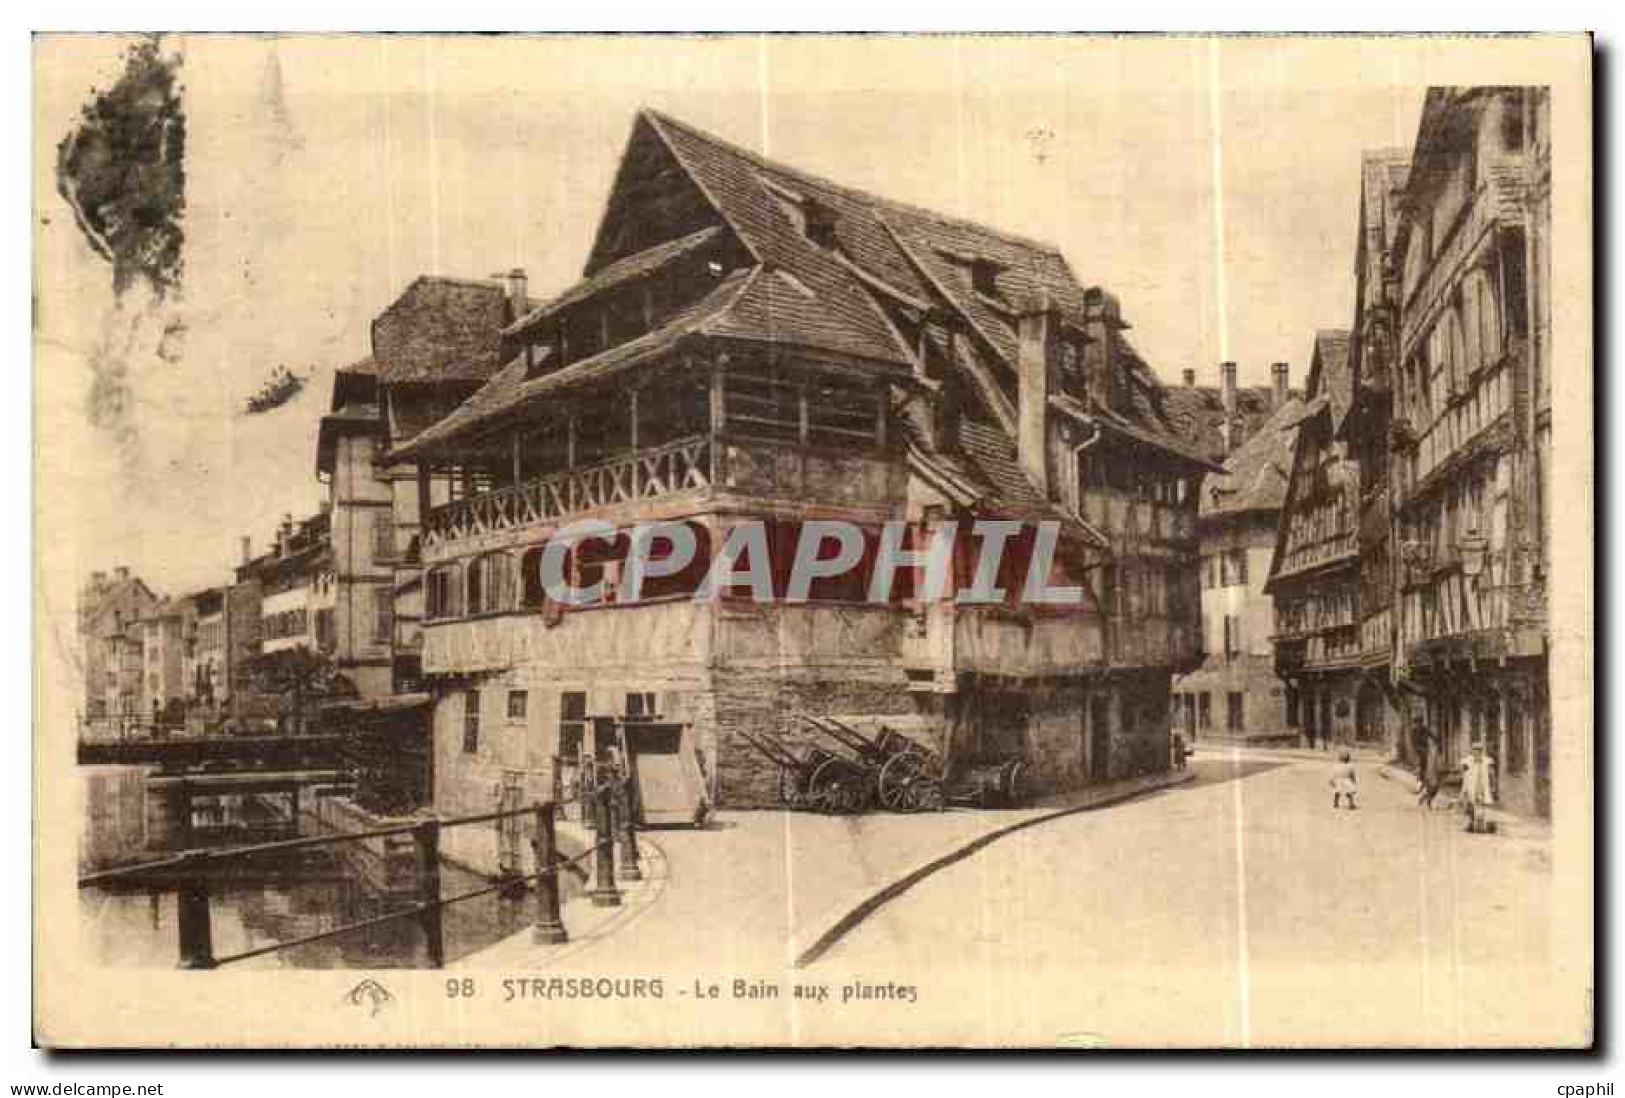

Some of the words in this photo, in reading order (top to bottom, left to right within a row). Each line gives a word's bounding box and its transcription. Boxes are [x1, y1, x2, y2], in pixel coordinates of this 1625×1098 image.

[446, 978, 475, 999] 98
[502, 978, 664, 1000] STRASBOURG
[695, 980, 720, 999] Le
[732, 979, 779, 999] Bain
[793, 985, 830, 1003] aux
[842, 981, 918, 1003] plantes
